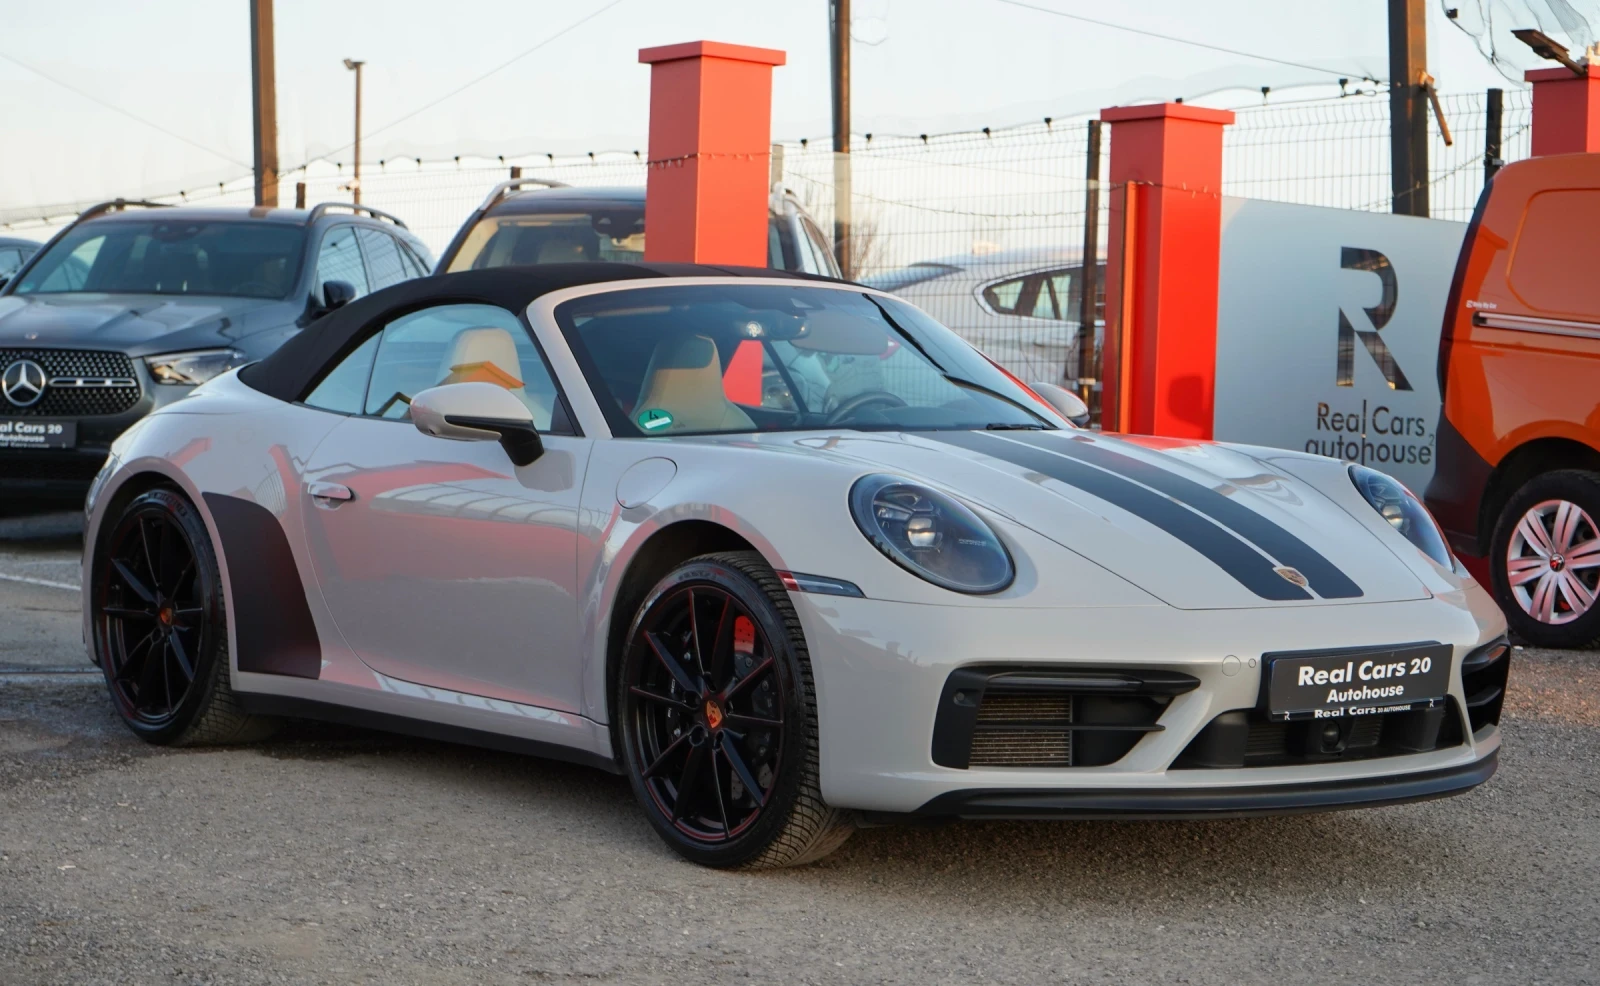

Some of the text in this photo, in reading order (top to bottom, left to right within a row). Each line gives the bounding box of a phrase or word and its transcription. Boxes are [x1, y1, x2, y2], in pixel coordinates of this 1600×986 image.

[1336, 246, 1414, 391] R
[0, 421, 63, 434] al Cars 20
[1317, 399, 1425, 437] Real Cars
[1305, 435, 1432, 466] autohouse
[1298, 657, 1431, 686] Real Cars 20
[1326, 685, 1404, 703] Autohouse
[1314, 707, 1344, 719] Real
[1348, 705, 1377, 716] Cars
[1383, 704, 1411, 712] AUTOHOUSE
